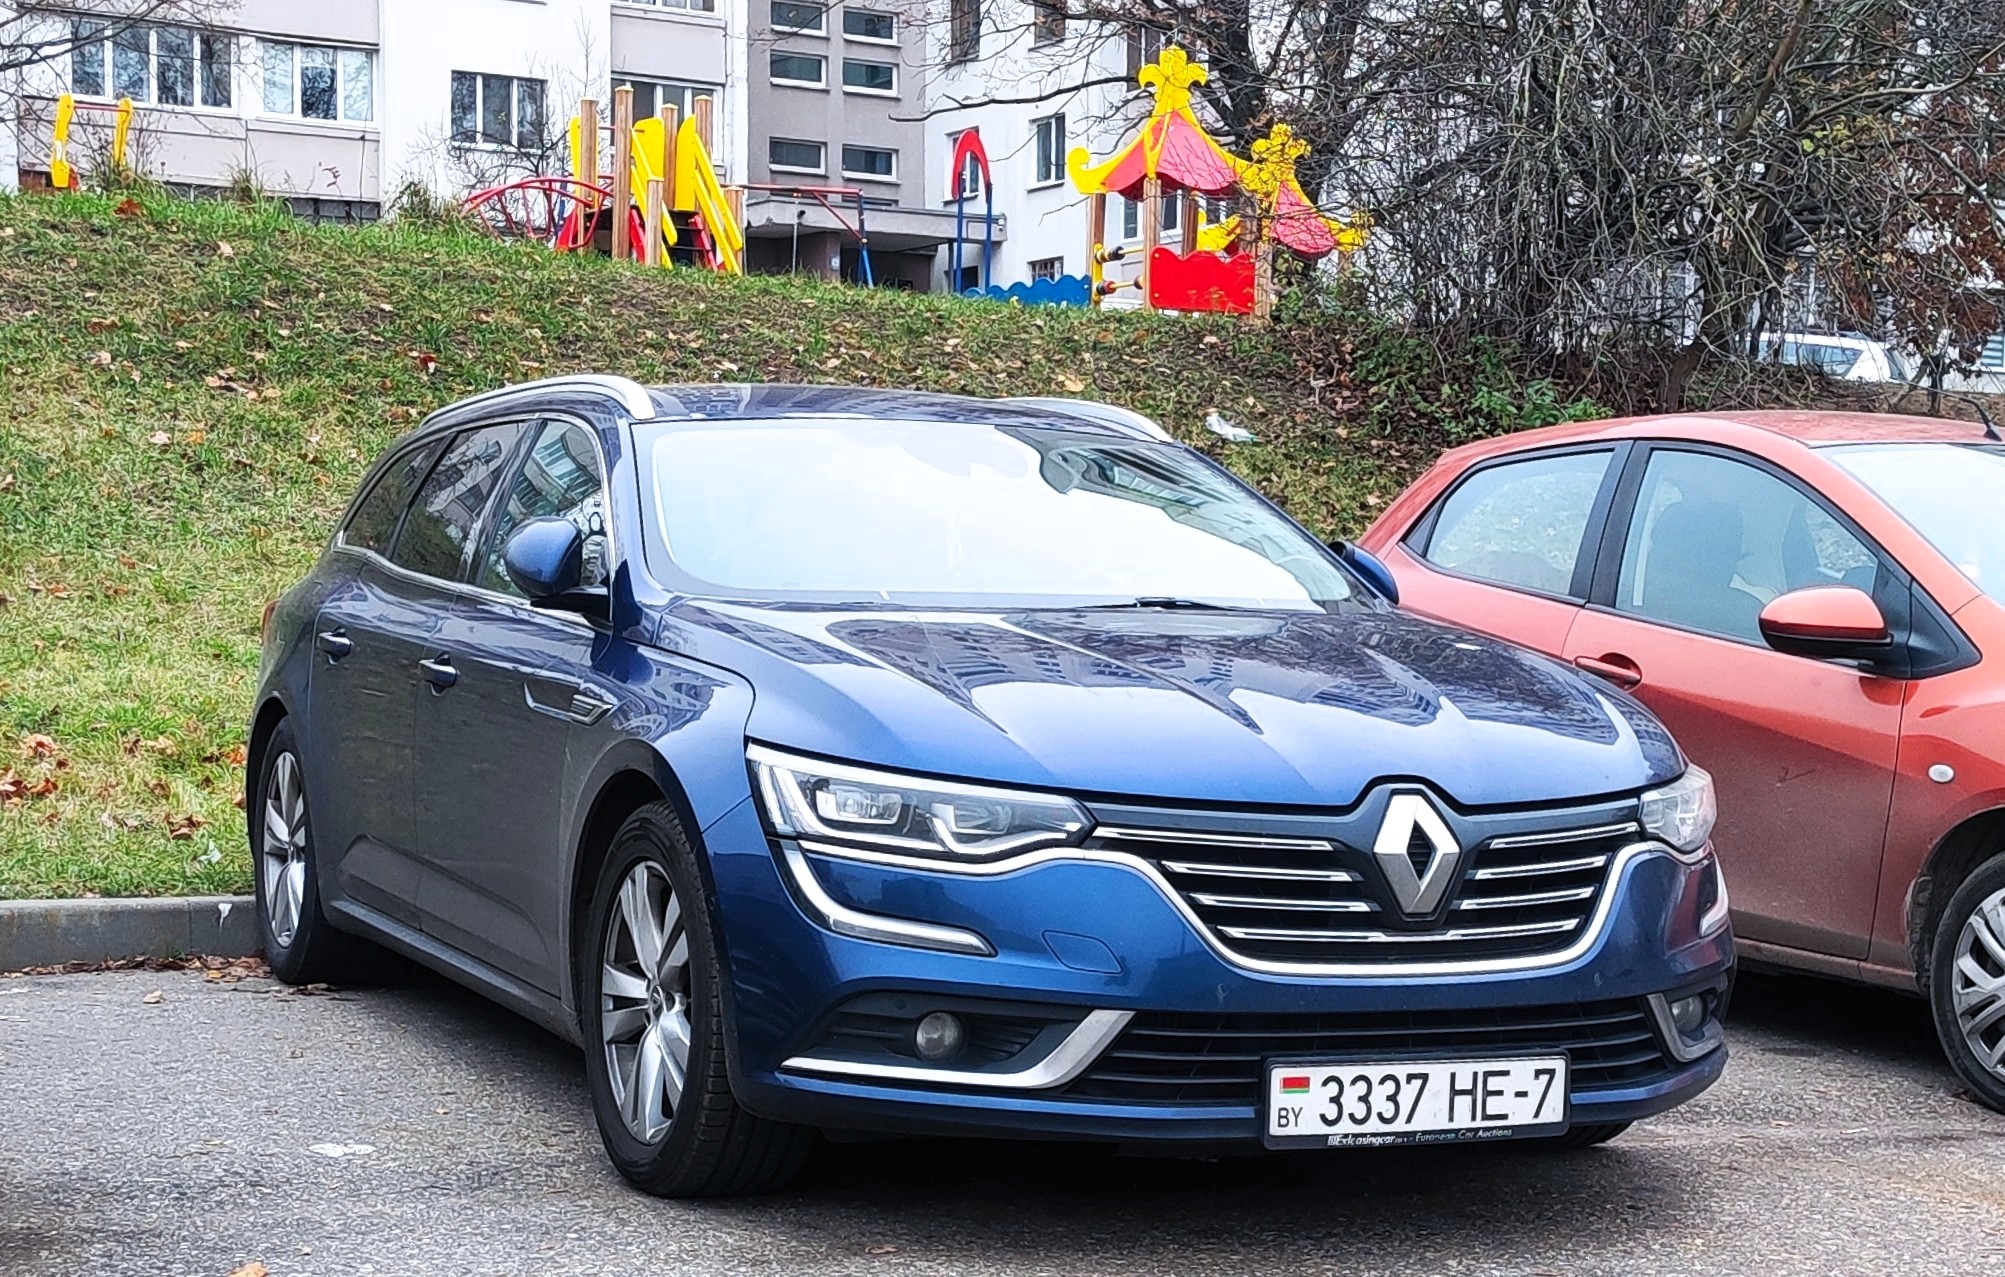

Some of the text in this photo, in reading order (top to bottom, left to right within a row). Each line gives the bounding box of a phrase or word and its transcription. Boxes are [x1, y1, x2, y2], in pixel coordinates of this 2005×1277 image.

[1319, 1067, 1557, 1127] 3337 HE-7
[1277, 1106, 1303, 1128] BY
[1476, 1127, 1513, 1138] Auctions
